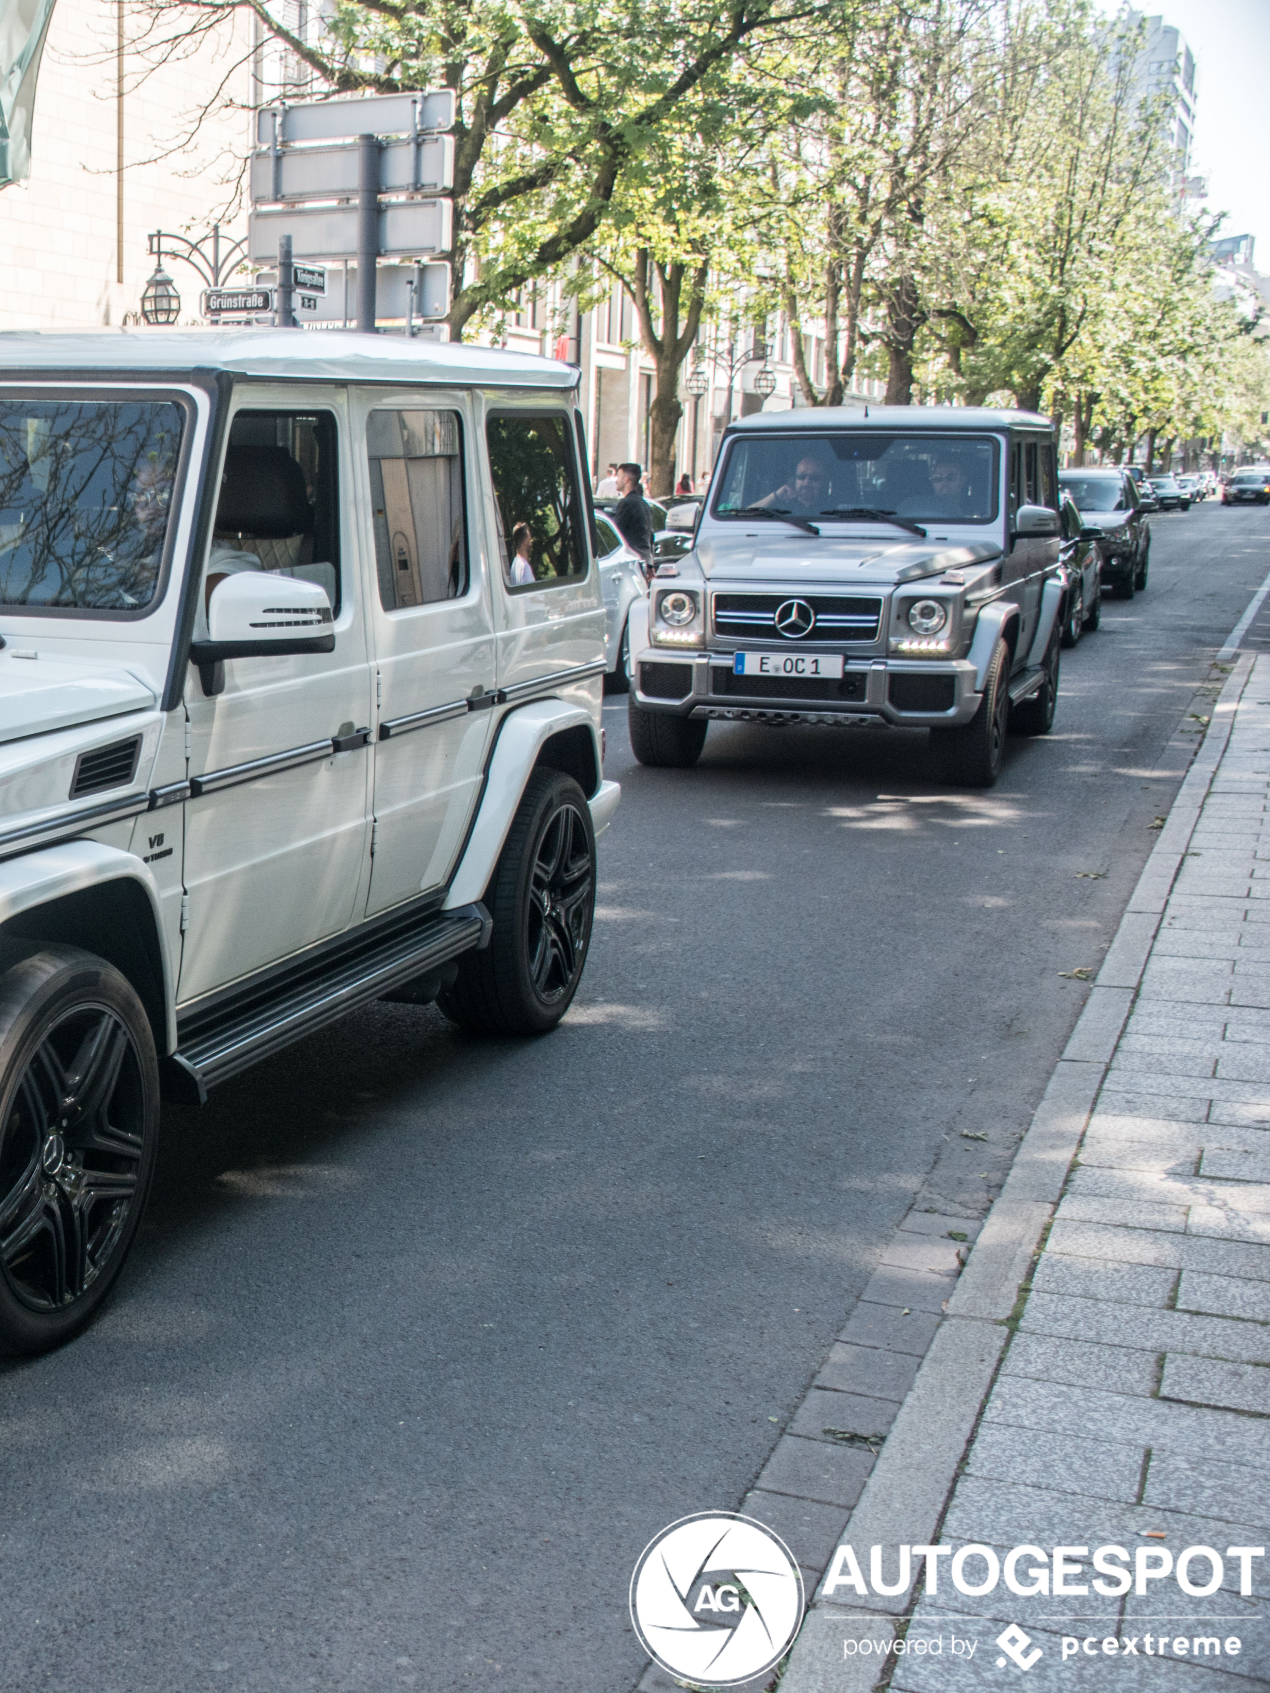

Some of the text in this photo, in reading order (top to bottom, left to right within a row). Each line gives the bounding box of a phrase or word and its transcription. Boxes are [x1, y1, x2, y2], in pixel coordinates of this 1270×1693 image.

[210, 293, 264, 310] Grünstraße
[759, 656, 770, 673] E
[783, 657, 806, 674] OC
[810, 658, 821, 675] 1
